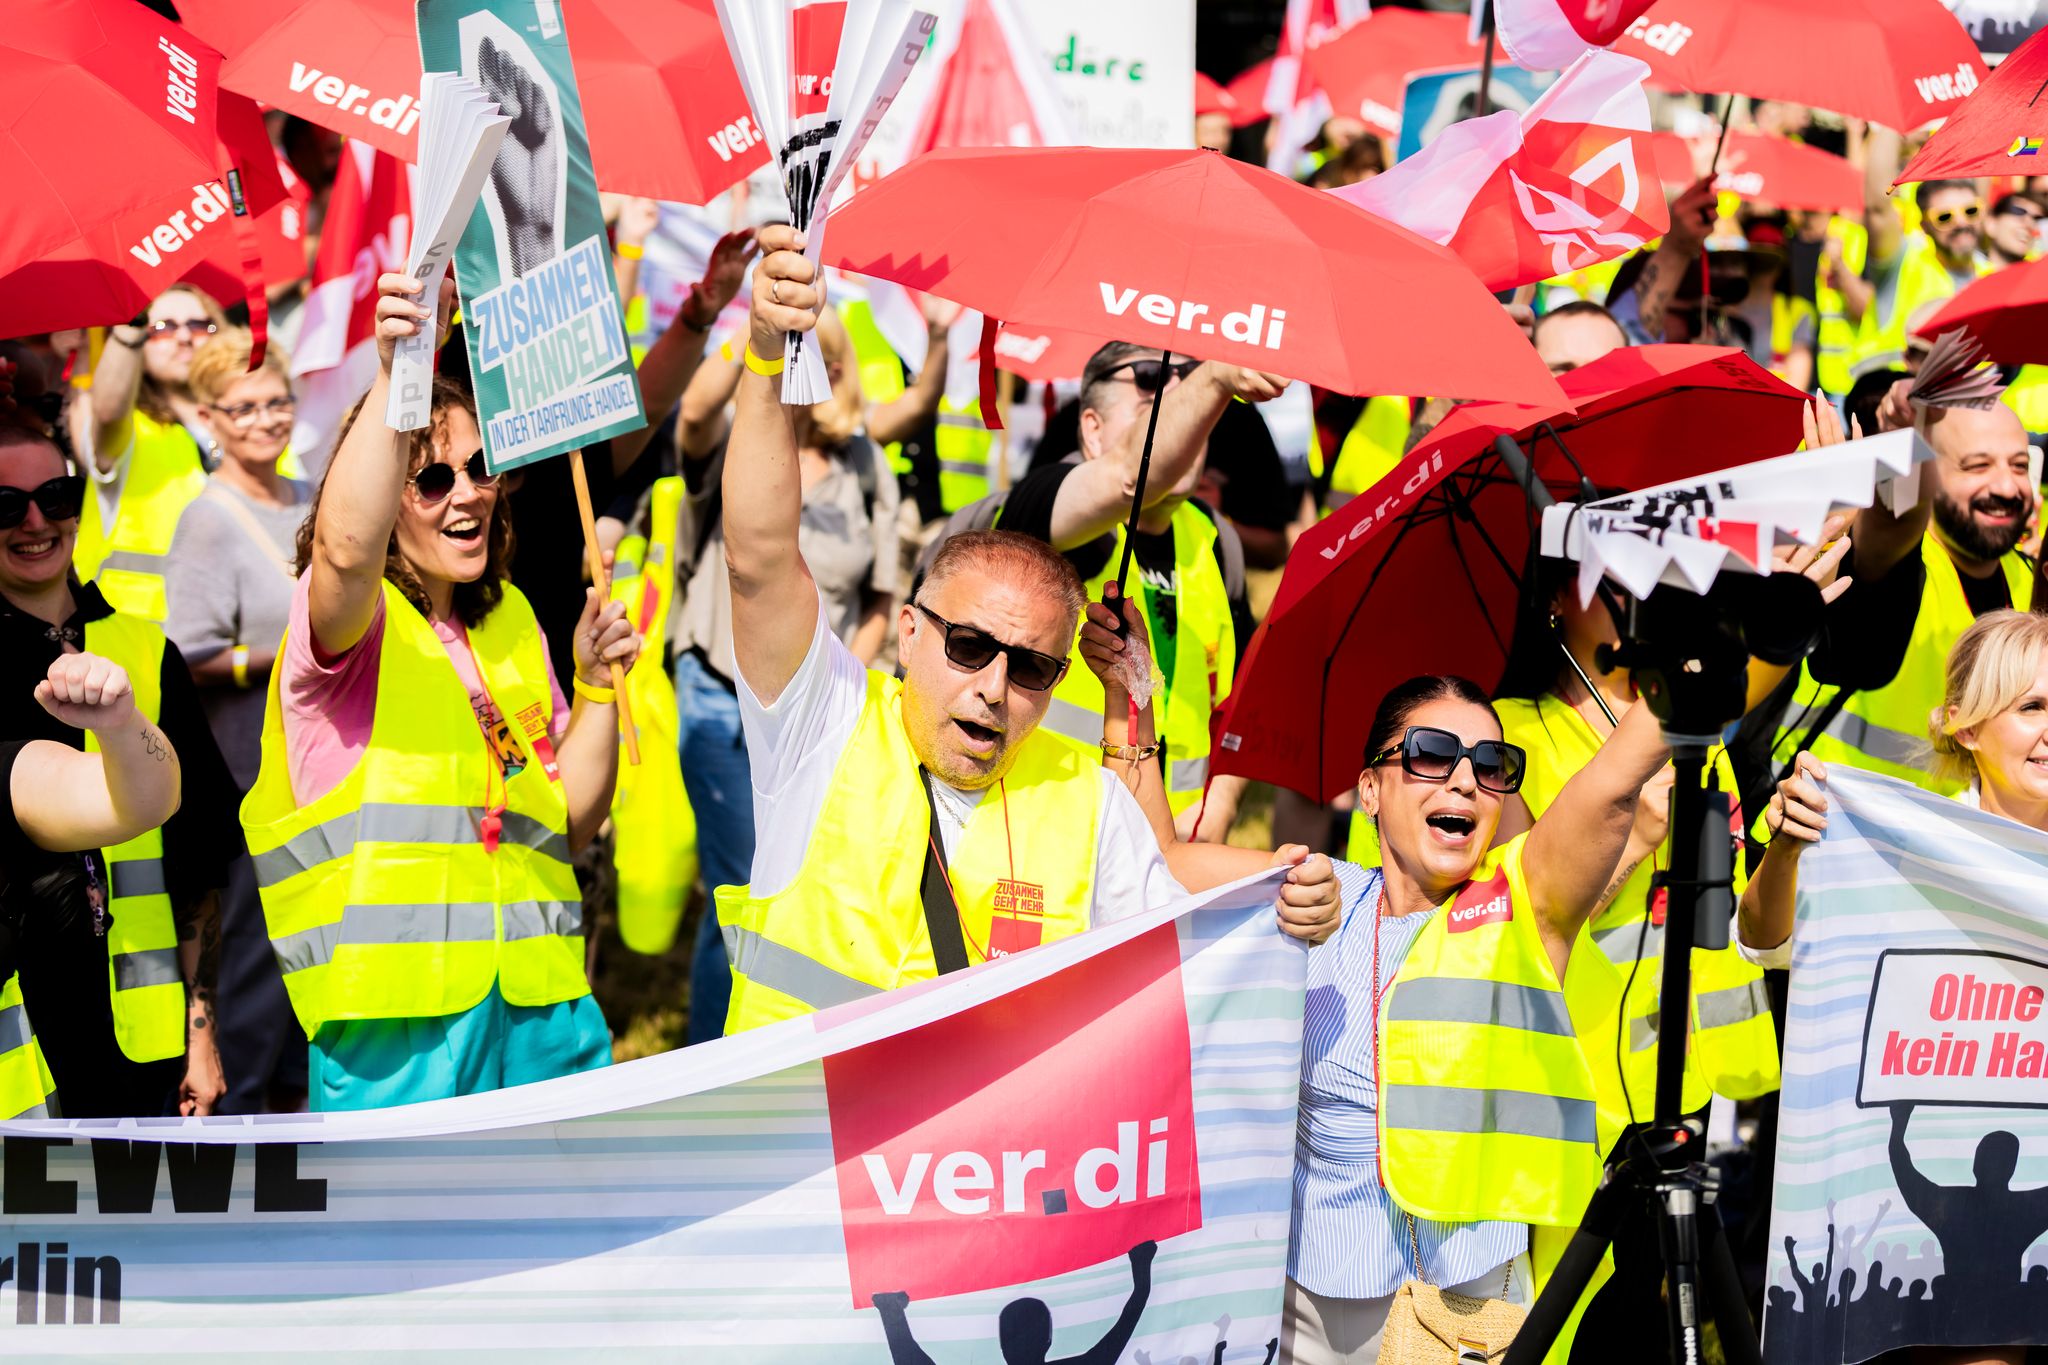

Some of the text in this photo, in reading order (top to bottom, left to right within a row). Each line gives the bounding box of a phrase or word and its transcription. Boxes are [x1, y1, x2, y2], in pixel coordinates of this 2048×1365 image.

[158, 36, 198, 124] ver.di
[289, 61, 421, 135] ver.di
[1914, 63, 1979, 104] ver.di
[129, 181, 231, 268] ver.di
[475, 242, 607, 365] ZUSAMMEN
[1099, 281, 1287, 350] ver.di
[506, 301, 623, 414] HANDELN
[491, 379, 635, 451] IN DER TARIFRUNDE HANDEL
[1319, 449, 1443, 560] ver.di
[993, 895, 1044, 913] GEHT MEHR
[996, 882, 1044, 901] ZUSAMMEN
[1451, 896, 1508, 922] ver.di
[1929, 973, 2045, 1022] Ohne
[1880, 1030, 1980, 1077] kein
[862, 1116, 1168, 1216] ver.di
